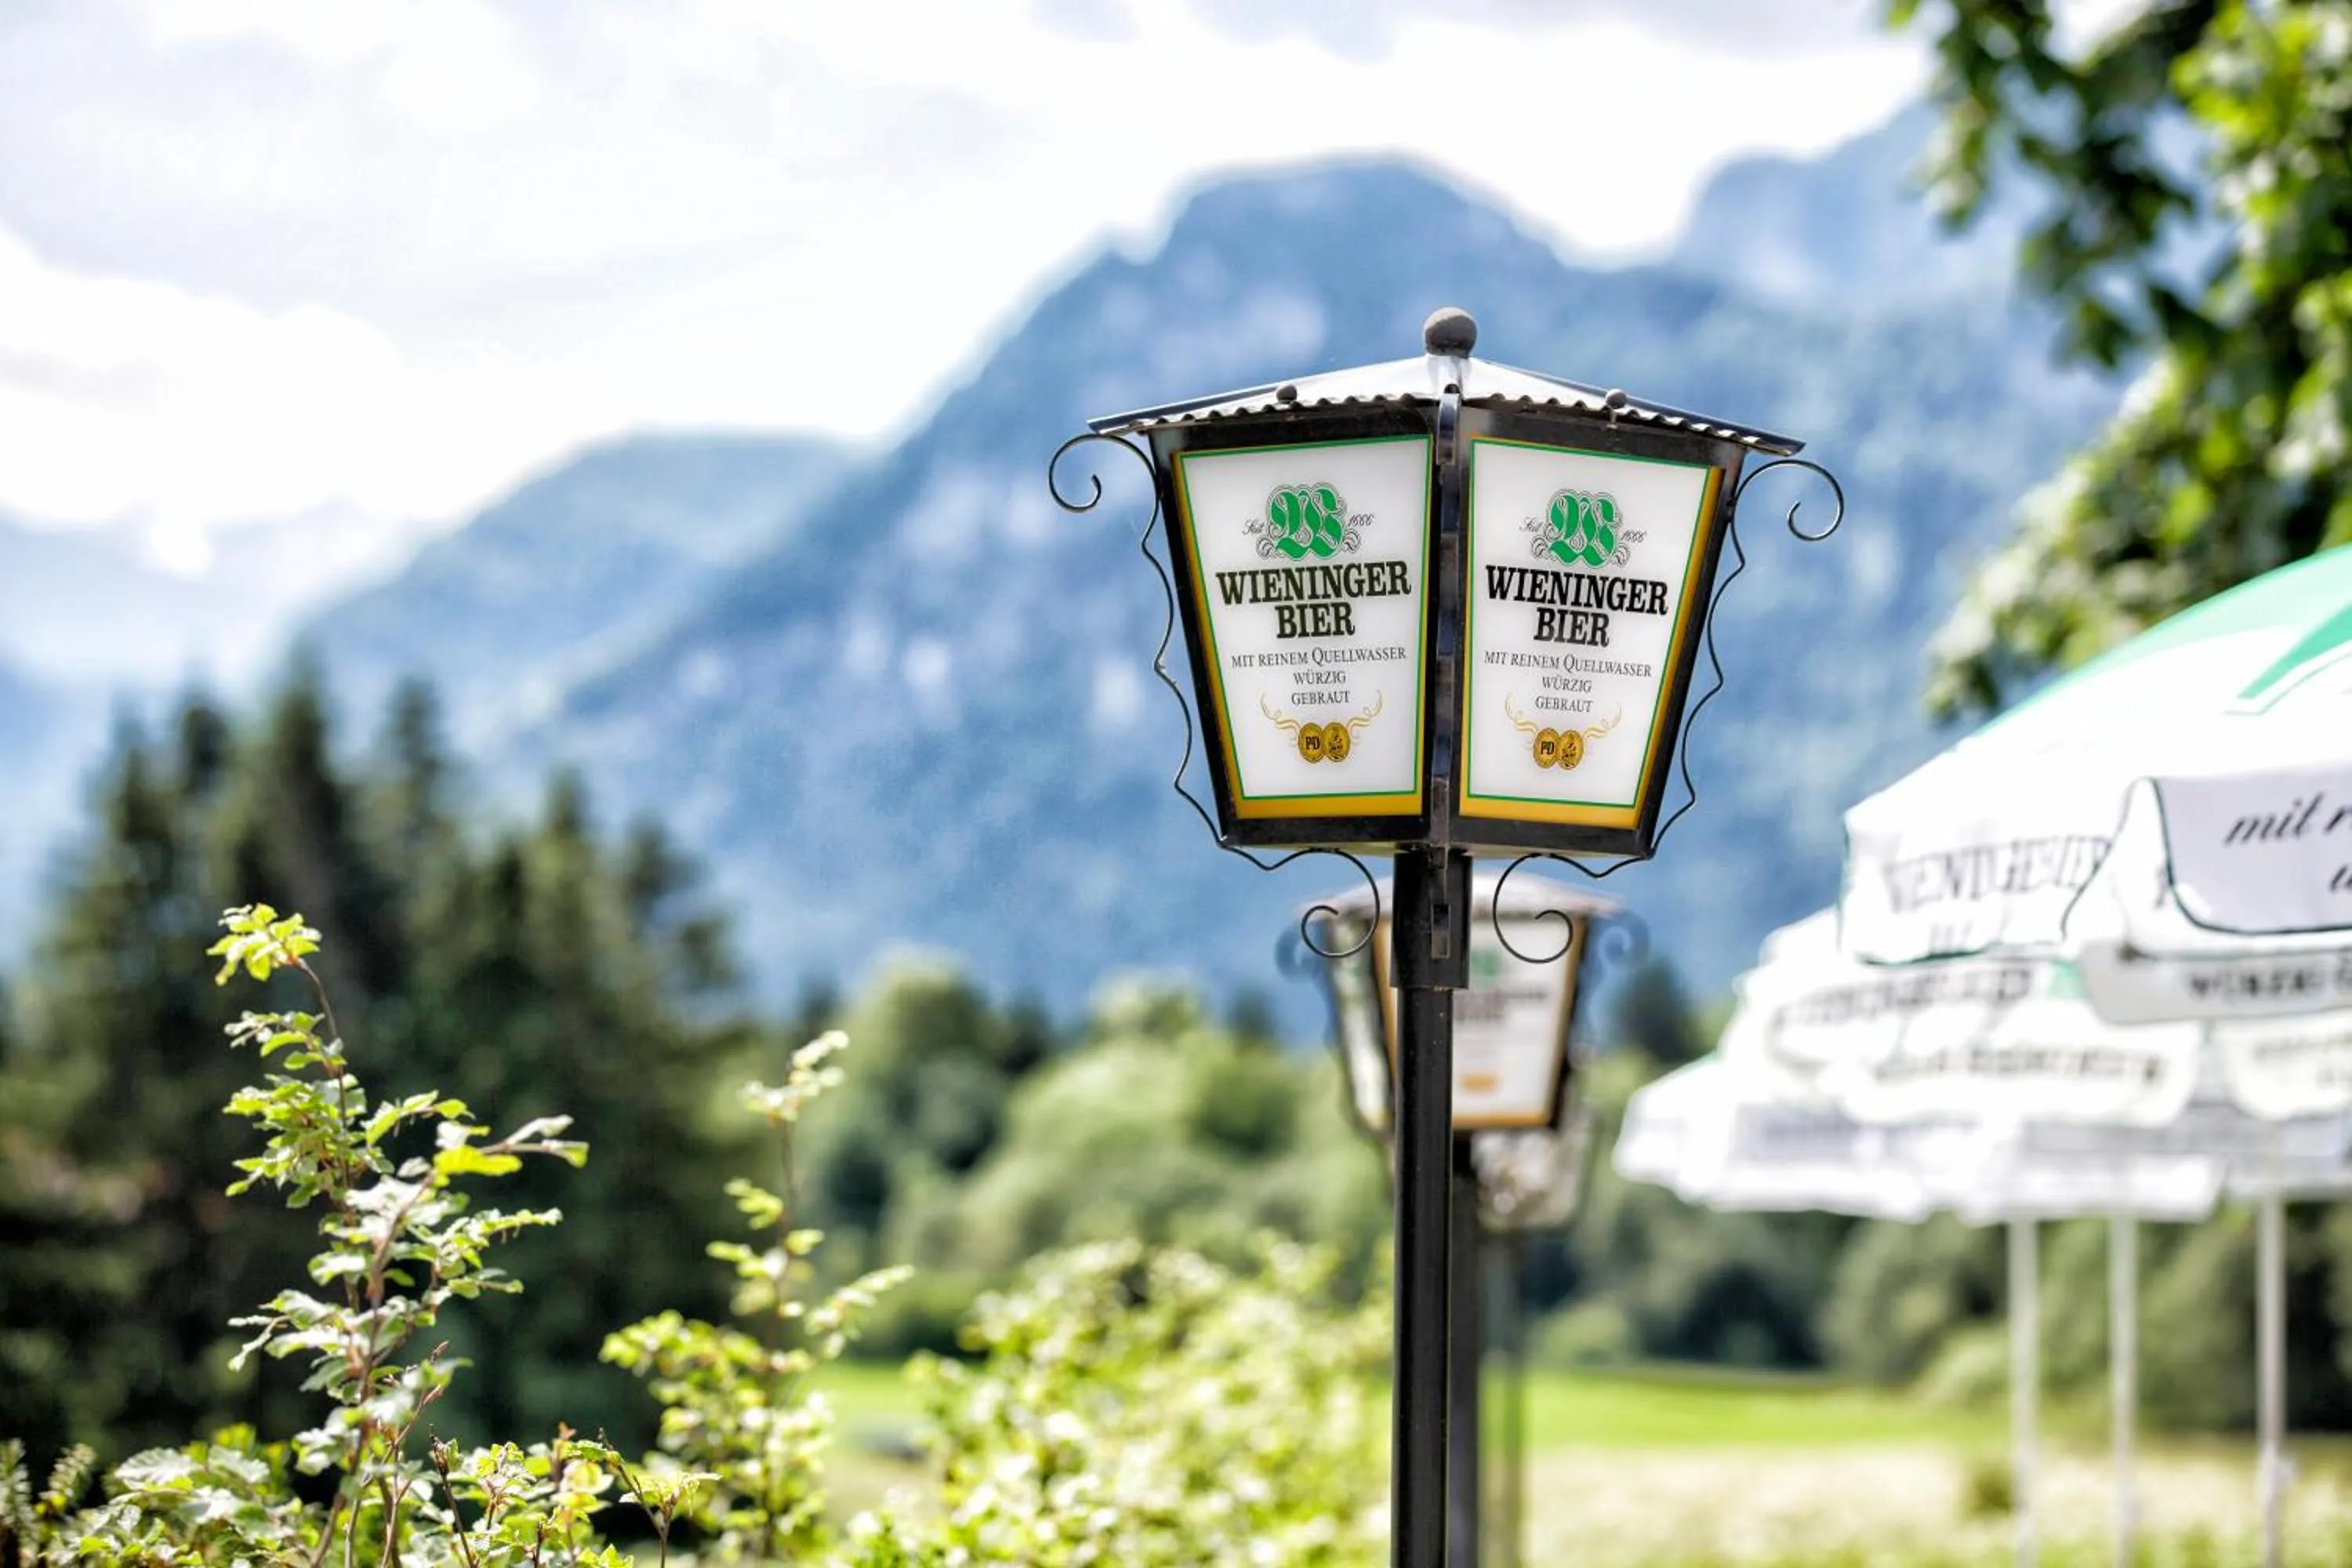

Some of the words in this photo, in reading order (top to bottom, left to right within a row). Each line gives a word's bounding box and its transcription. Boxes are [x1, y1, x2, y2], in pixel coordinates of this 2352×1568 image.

[1216, 561, 1410, 604] WIENINGER
[1486, 565, 1668, 615] WIENINGER
[1275, 602, 1355, 638] BIER
[1534, 608, 1609, 646] BIER
[1232, 655, 1254, 668] MIT
[1258, 652, 1308, 666] REINEM
[1312, 647, 1406, 666] QUELLWASSER
[1484, 651, 1508, 665] MIT
[1511, 655, 1559, 669] REINEM
[1563, 655, 1651, 677] QUELLWASSER
[1293, 670, 1346, 684] WÜRZIG
[1542, 676, 1592, 691] WÜRZIG
[1291, 691, 1350, 705] GEBRAUT
[1536, 697, 1593, 713] GEBRAUT
